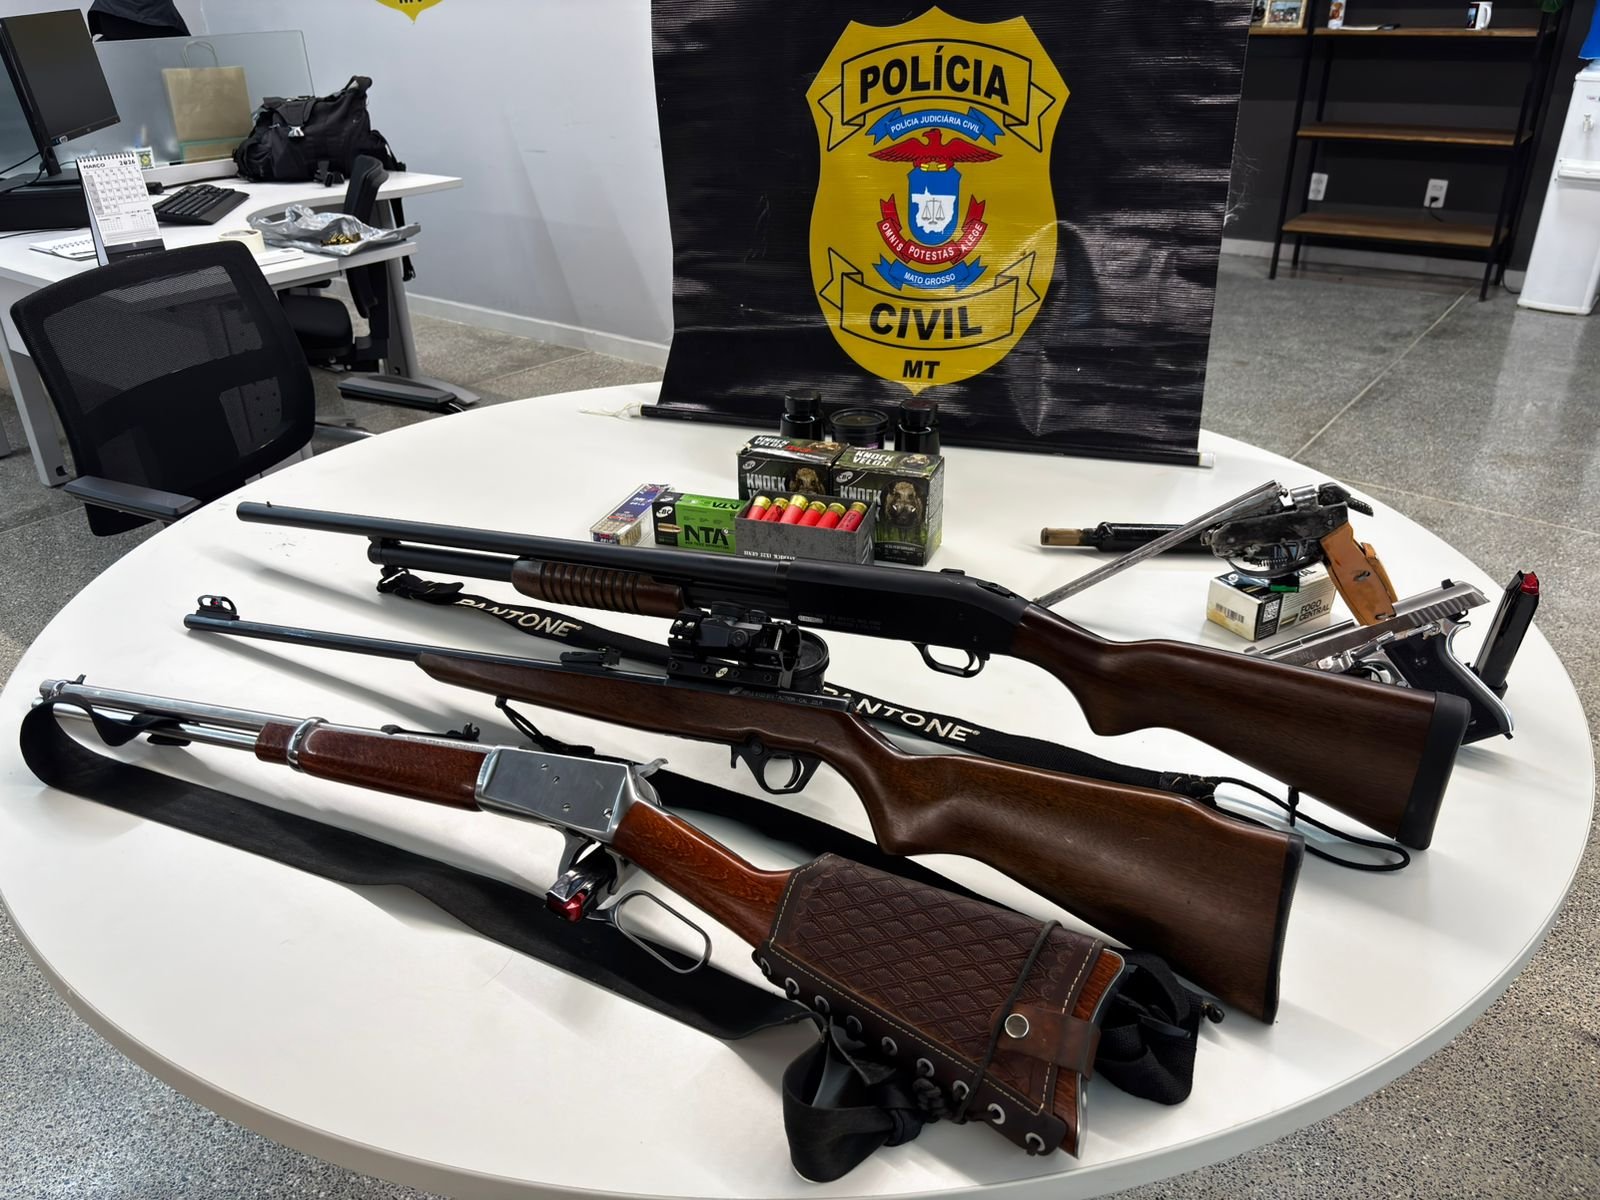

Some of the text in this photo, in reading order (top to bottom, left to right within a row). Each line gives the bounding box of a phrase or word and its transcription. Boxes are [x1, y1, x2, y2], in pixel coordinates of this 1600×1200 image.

[860, 45, 1009, 106] POLÍCIA
[890, 113, 980, 134] POLÍCIA JUDICIÁRIA CIVIL
[882, 222, 904, 252] OMNIS
[908, 245, 954, 261] POTESTAS
[904, 272, 956, 285] MATO GROSSO
[869, 303, 982, 340] CIVIL
[902, 360, 940, 379] MT
[853, 456, 890, 467] VELOX
[856, 450, 894, 462] KNOCK
[746, 473, 787, 492] KNOCK
[840, 486, 882, 506] KNOCK
[683, 524, 729, 546] NTA
[1300, 599, 1322, 613] FOGO
[1300, 604, 1330, 621] CENTRAL
